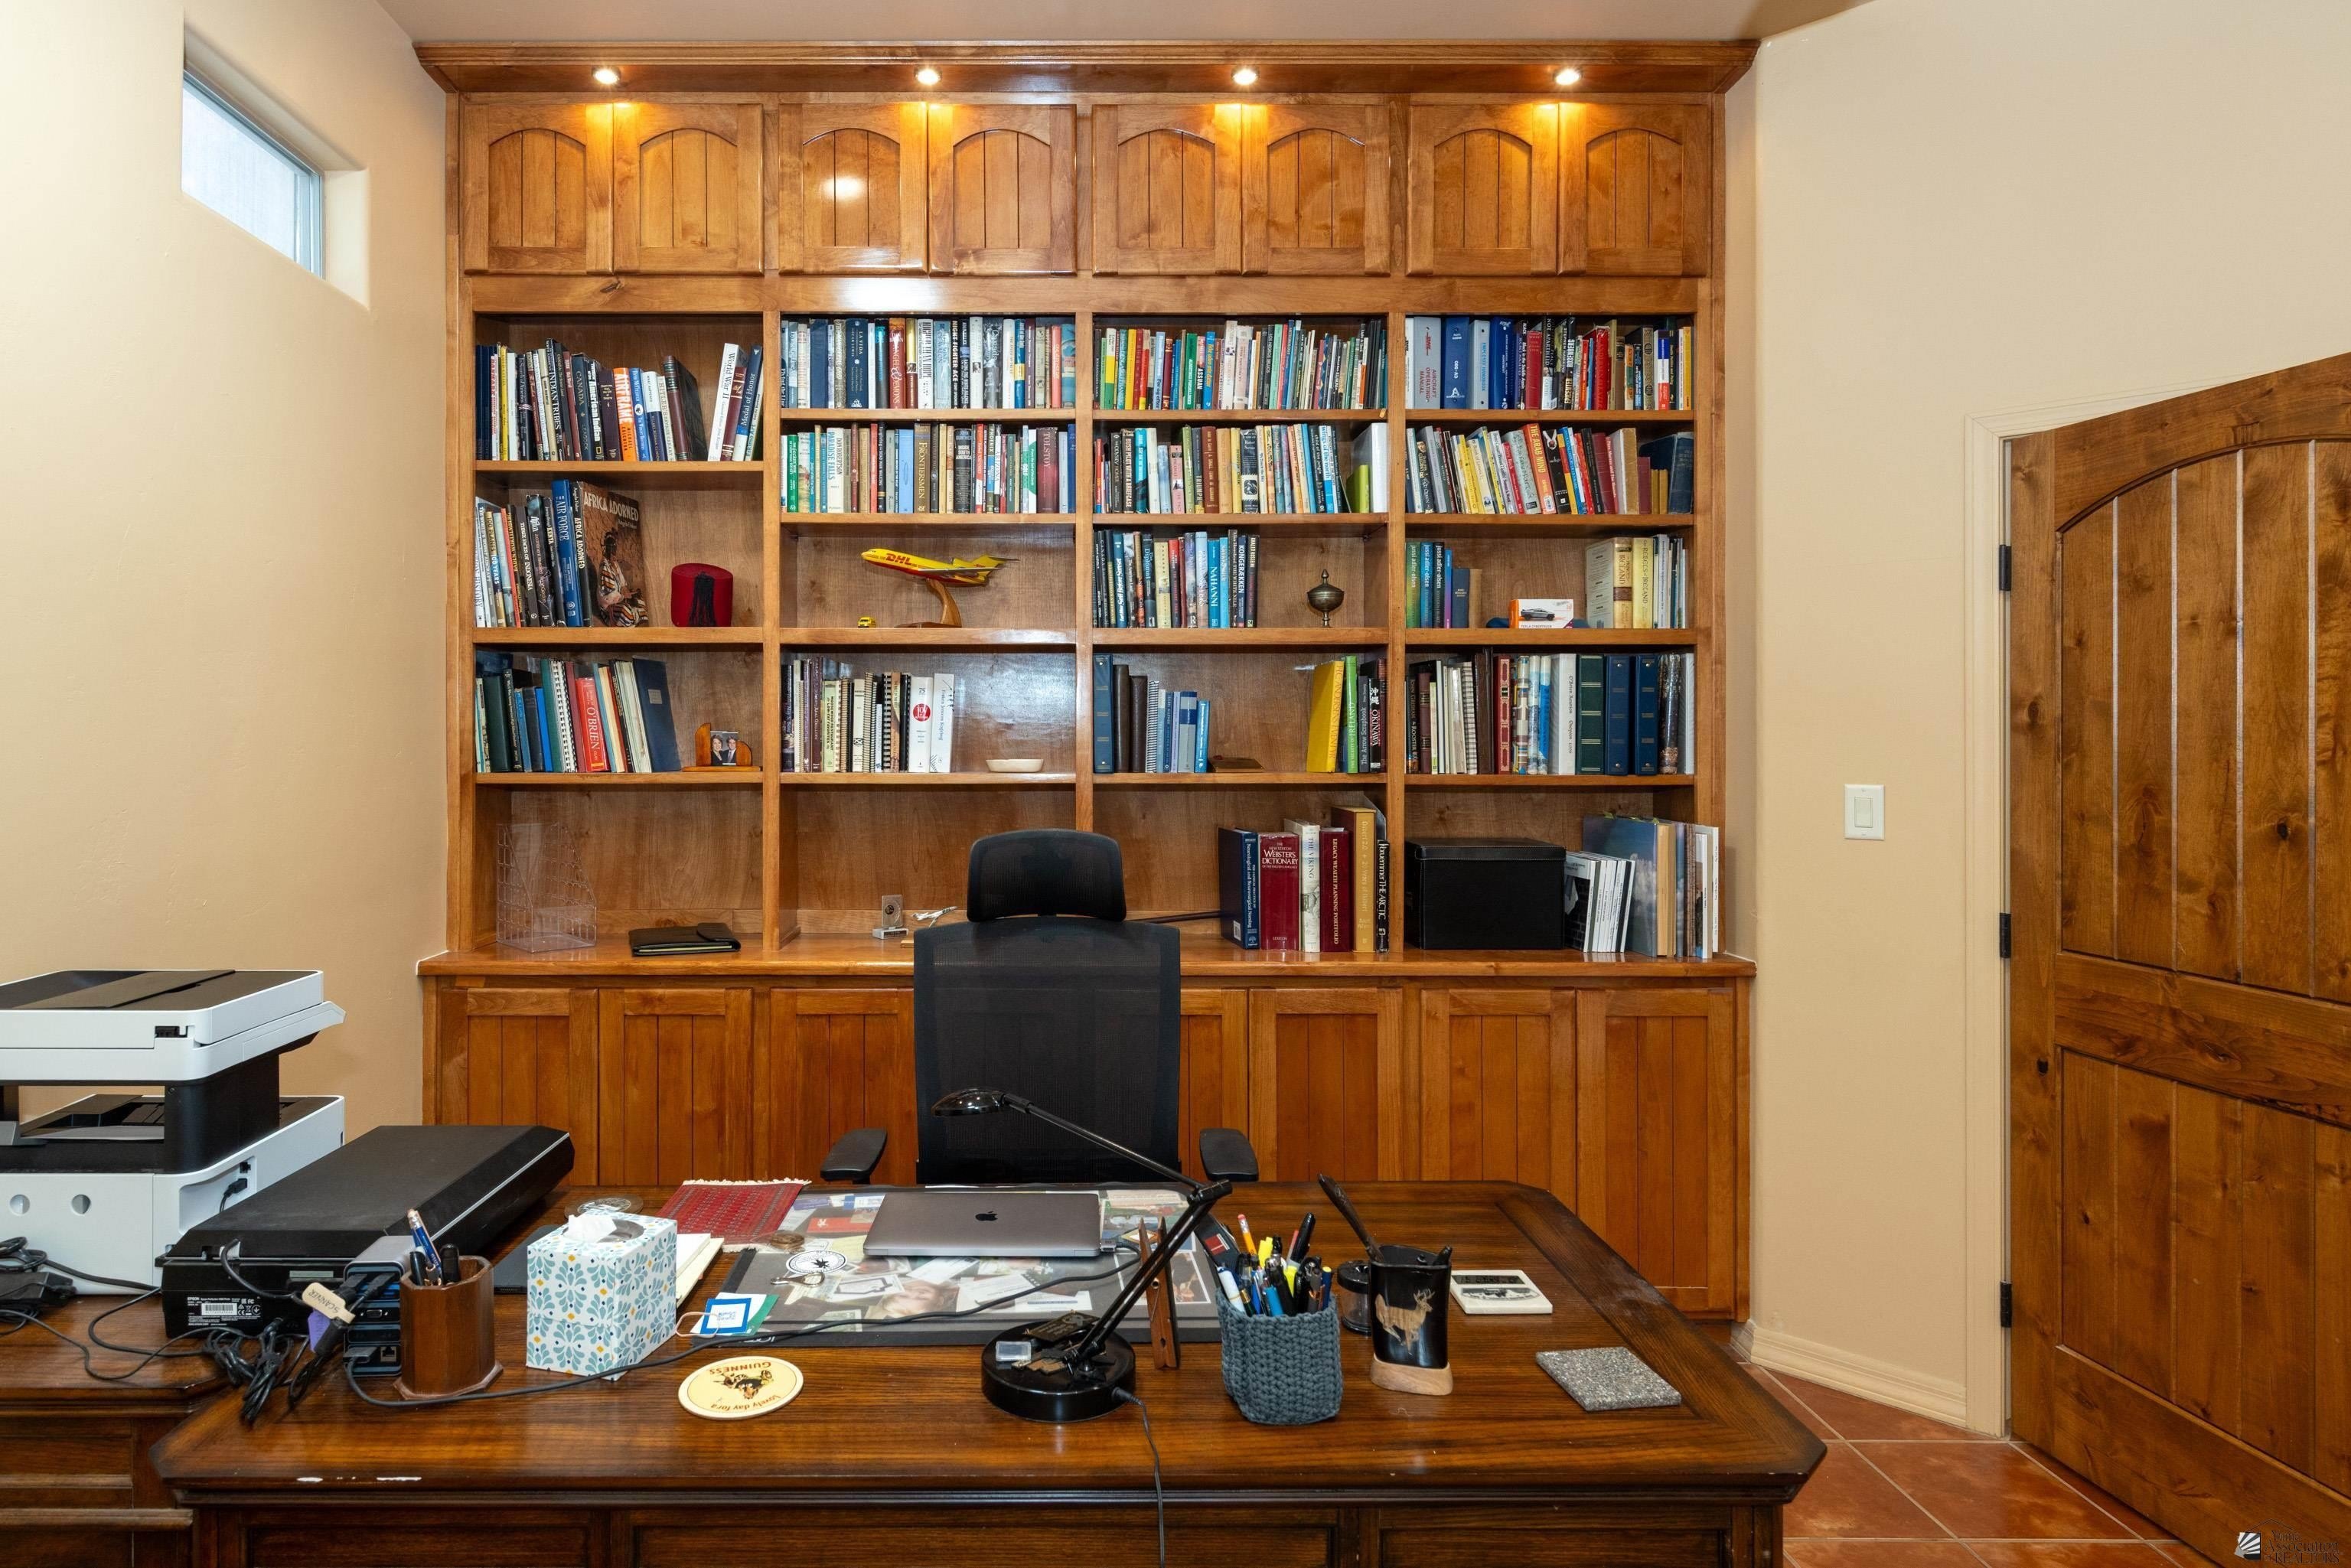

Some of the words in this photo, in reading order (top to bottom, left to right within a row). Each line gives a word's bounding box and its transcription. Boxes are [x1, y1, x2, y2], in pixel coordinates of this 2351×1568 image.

[923, 322, 931, 344] HIGHER
[923, 347, 931, 362] THAN
[1567, 339, 1575, 367] ROSENBERG
[891, 368, 902, 381] &
[923, 364, 931, 378] HOPE
[576, 370, 585, 406] CANADA
[615, 373, 632, 425] AIRFRAME
[659, 383, 667, 416] HITLER'S
[741, 406, 749, 425] Medal
[745, 395, 751, 404] of
[918, 442, 927, 498] FRONTIERSMEN
[1536, 457, 1545, 473] MIND
[556, 500, 566, 514] AIR
[583, 491, 608, 511] AFRICA
[608, 505, 639, 522] ADORNED
[557, 516, 569, 541] FORCE
[576, 540, 585, 569] ADORNED
[885, 553, 912, 566] DHL
[523, 562, 533, 591] INDONESIA
[1264, 849, 1296, 858] WEBSTER'S
[307, 1289, 341, 1314] SCANNER
[709, 1361, 771, 1375] GUINNESS
[753, 1394, 781, 1407] Lovely
